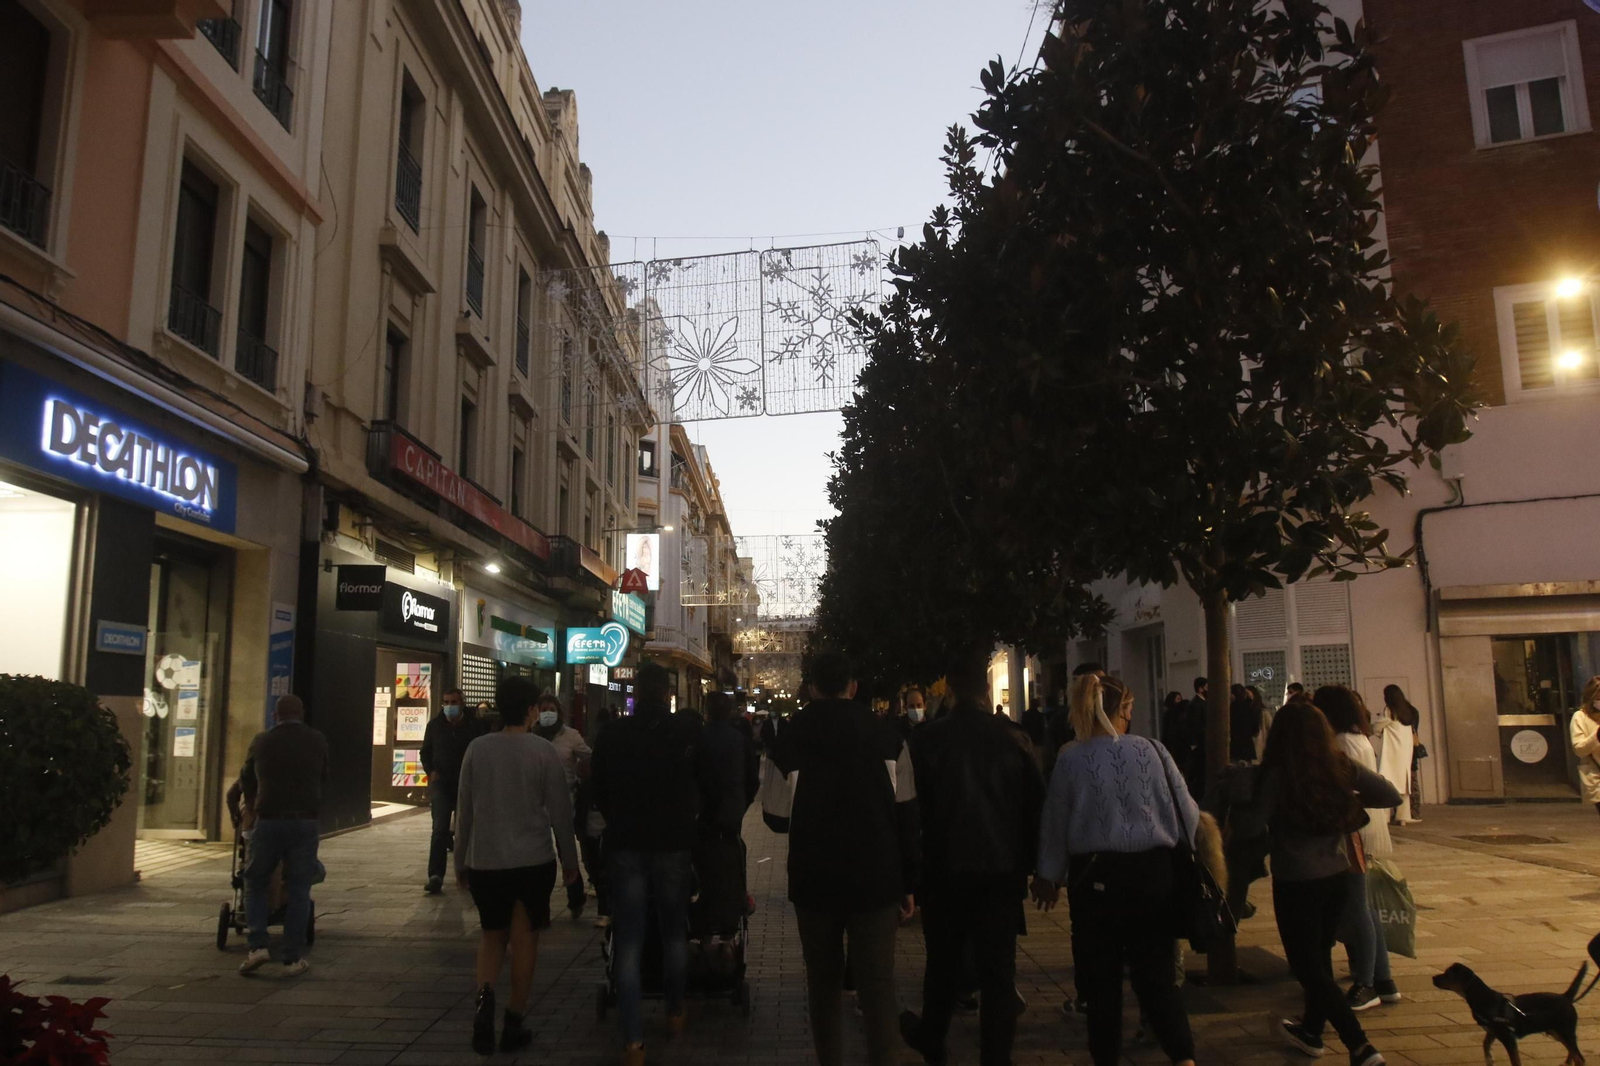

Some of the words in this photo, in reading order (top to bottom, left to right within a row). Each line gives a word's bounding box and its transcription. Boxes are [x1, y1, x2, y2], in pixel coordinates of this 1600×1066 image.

[42, 398, 219, 510] DECATHLON
[405, 445, 466, 507] CAPITAN
[339, 582, 382, 594] flormar
[574, 639, 606, 648] EFETA
[615, 668, 633, 678] 12H
[400, 708, 425, 716] COLOR
[400, 723, 423, 731] EVERY
[404, 731, 419, 739] YOU
